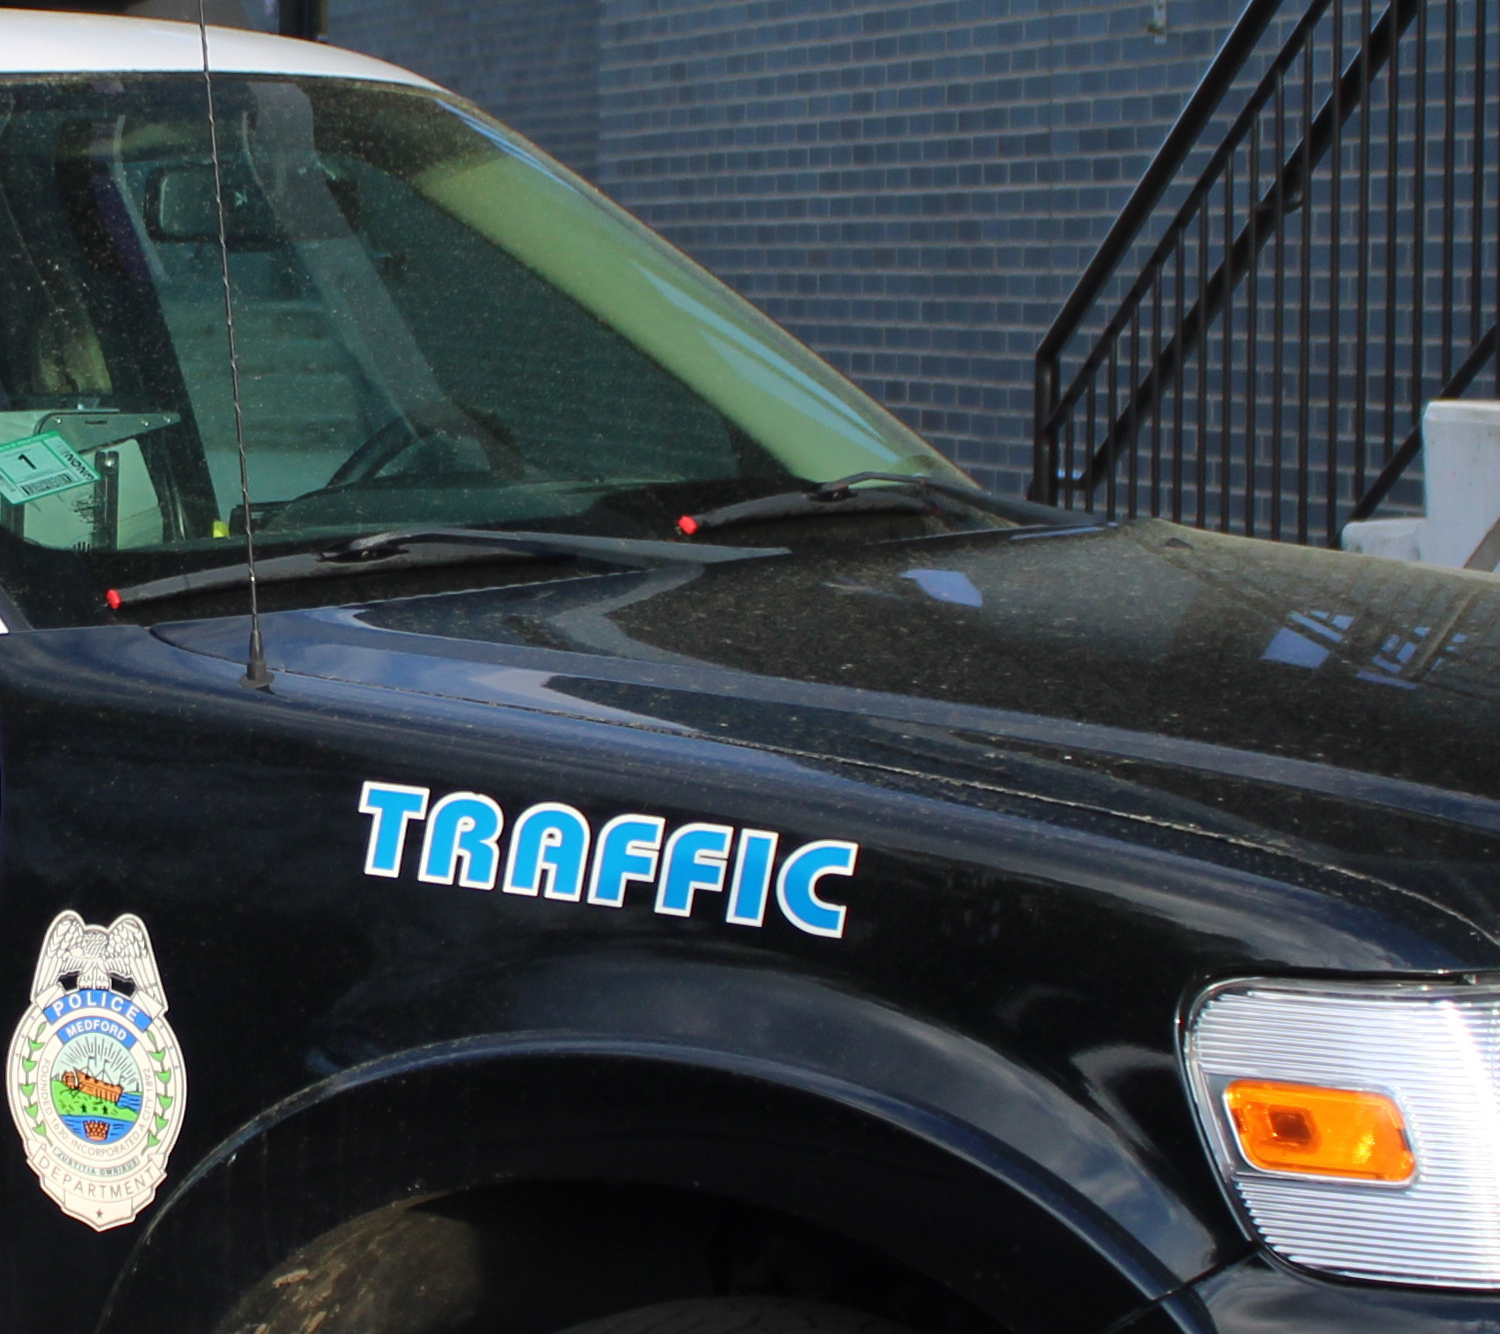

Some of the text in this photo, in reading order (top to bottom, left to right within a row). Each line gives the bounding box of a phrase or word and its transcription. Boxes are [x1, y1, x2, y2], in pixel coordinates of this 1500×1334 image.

[358, 781, 859, 939] TRAFFIC
[52, 991, 140, 1022] POLICE
[65, 1019, 127, 1041] MEDFORD
[40, 1058, 53, 1116] FOUNDED
[70, 1132, 140, 1156] INCORPORATED
[142, 1097, 153, 1121] CITY
[38, 1155, 155, 1199] DEPARTMENT
